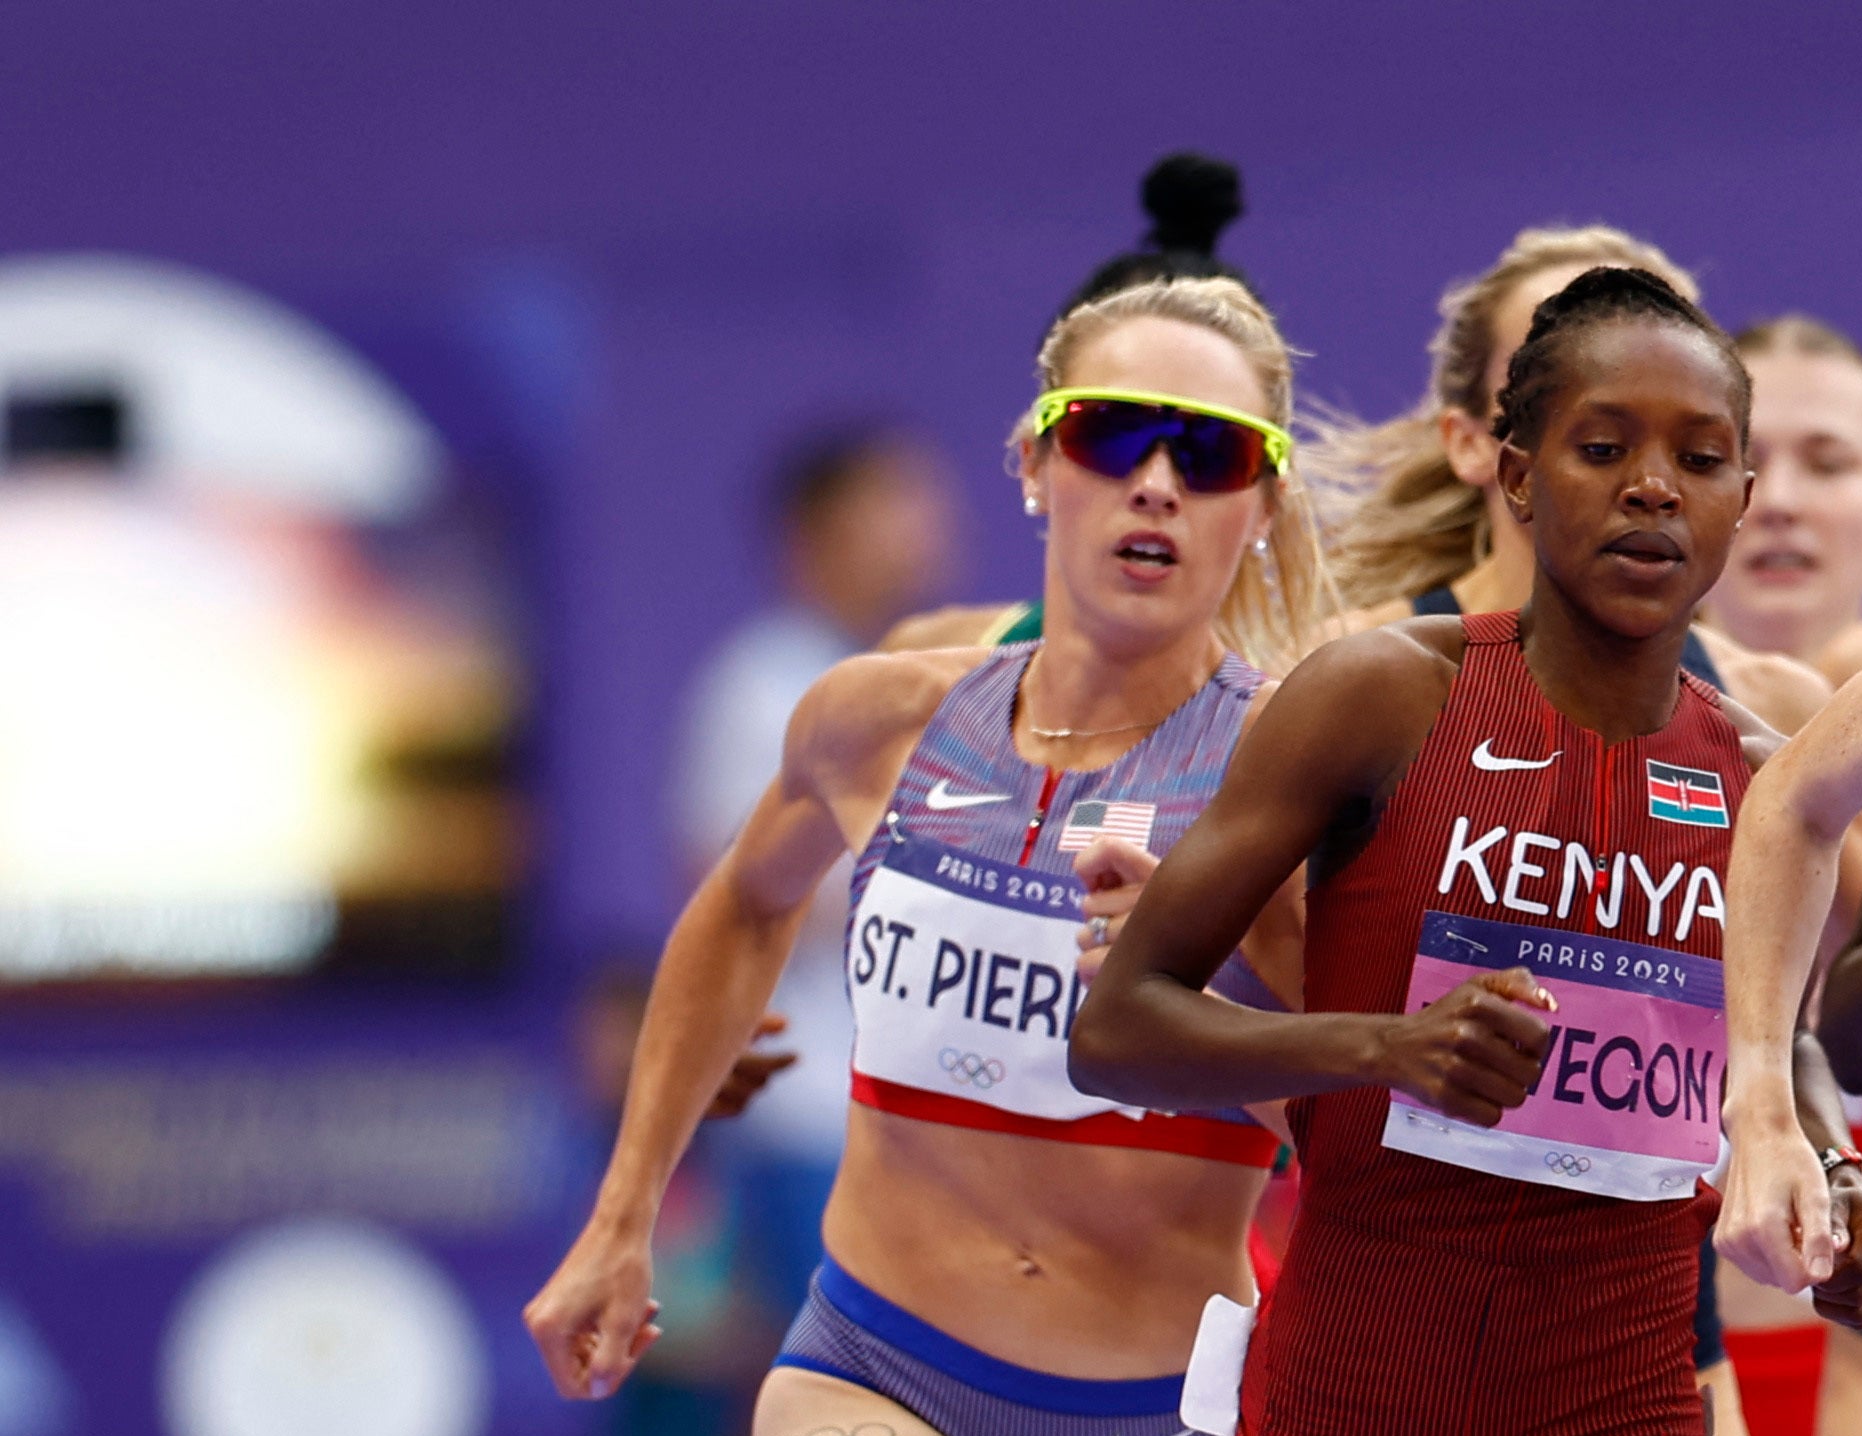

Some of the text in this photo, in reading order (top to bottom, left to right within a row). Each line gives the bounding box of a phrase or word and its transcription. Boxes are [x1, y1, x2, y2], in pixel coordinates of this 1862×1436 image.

[1006, 876, 1084, 910] 2024
[1437, 816, 1725, 942] KENYA
[855, 914, 916, 1000] ST.
[1615, 955, 1687, 988] 2024
